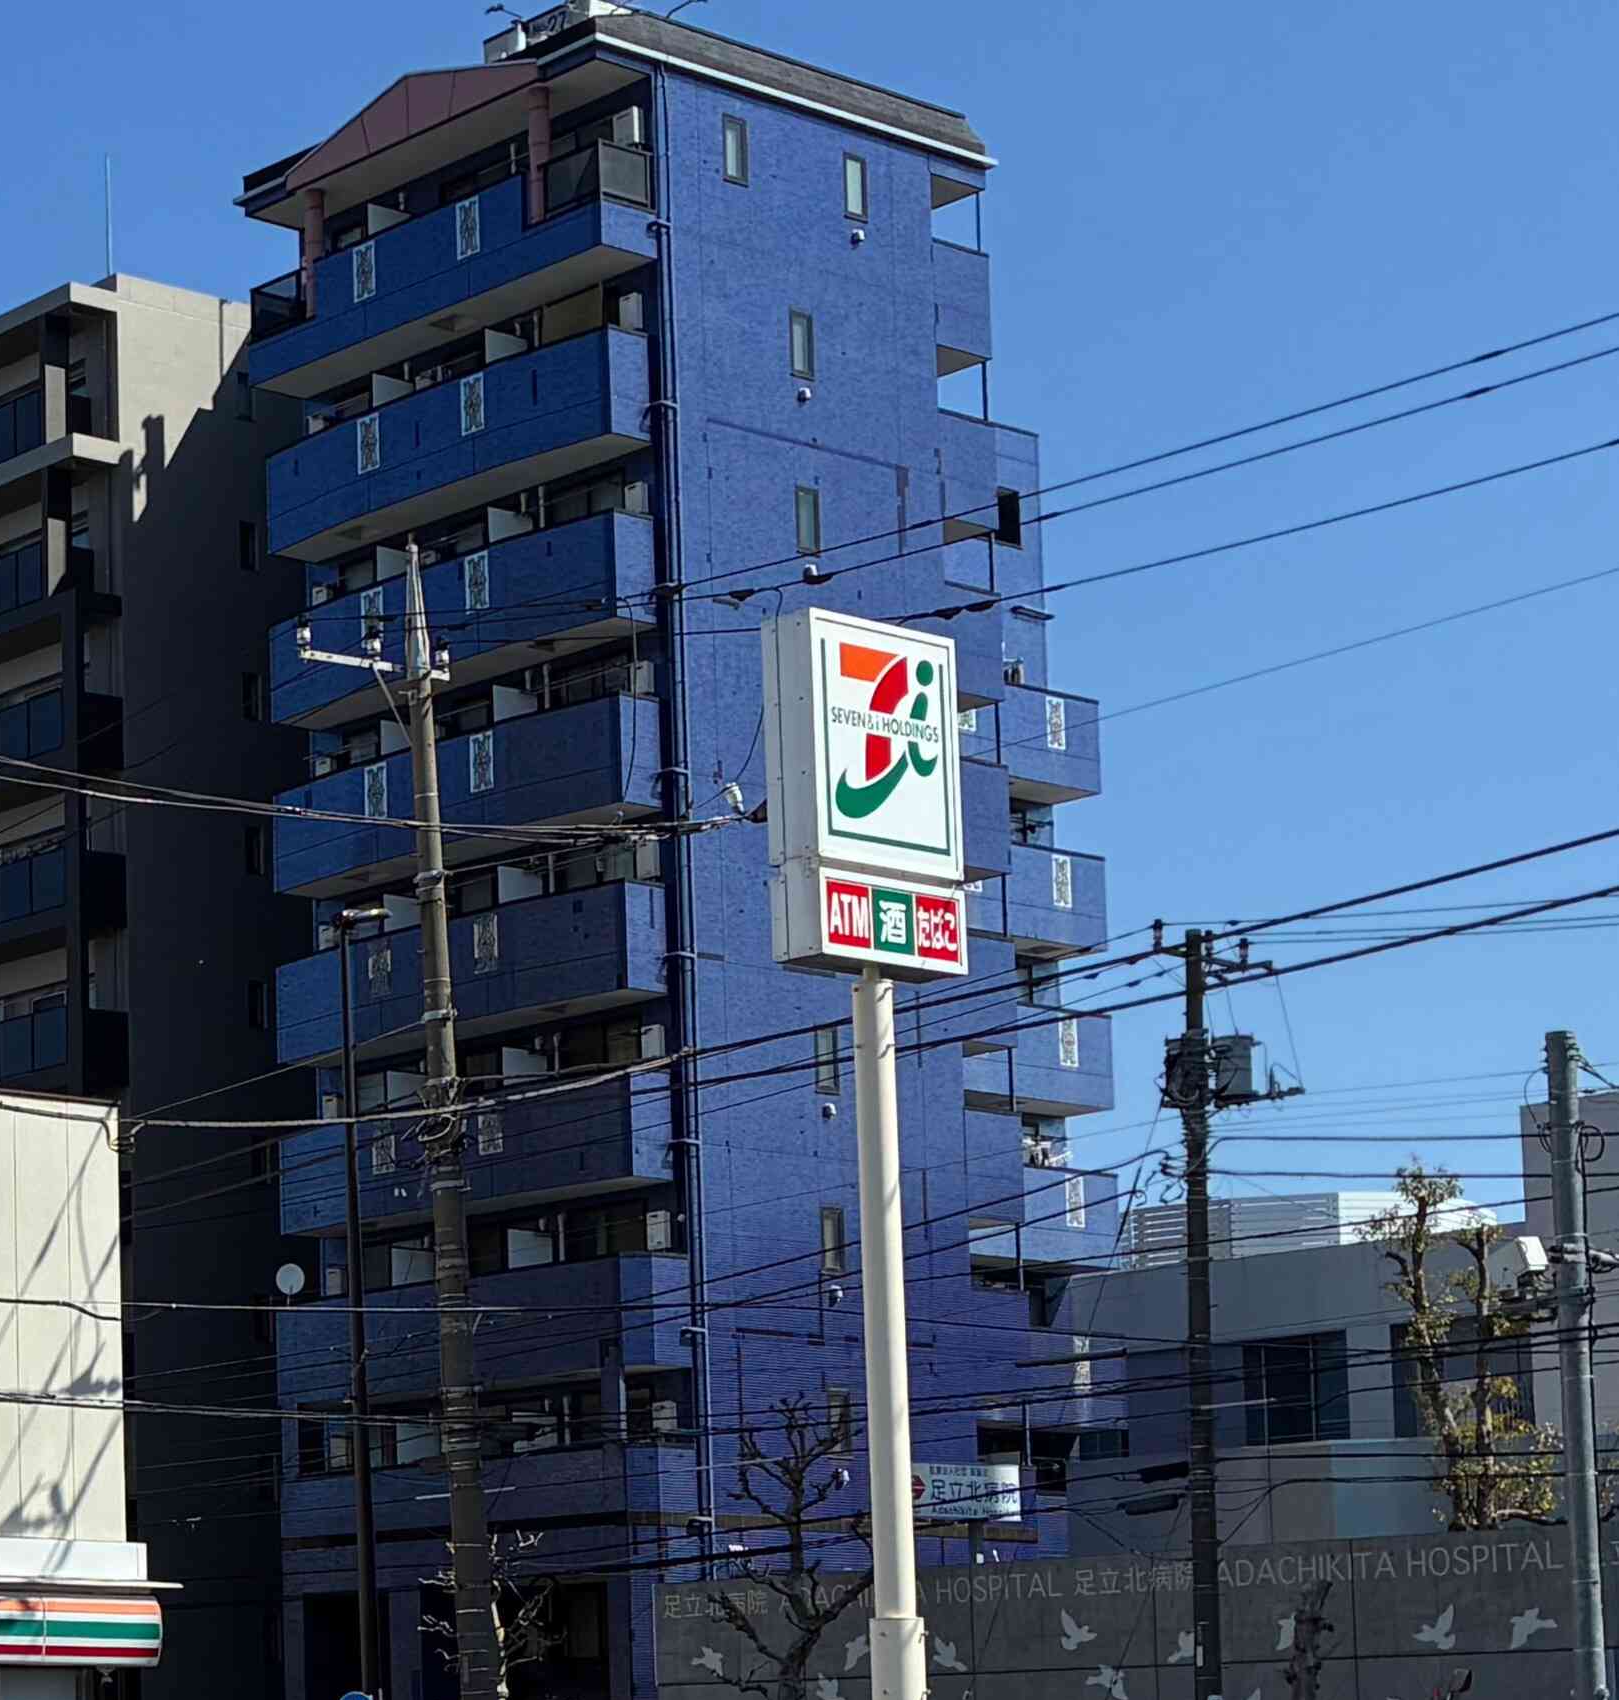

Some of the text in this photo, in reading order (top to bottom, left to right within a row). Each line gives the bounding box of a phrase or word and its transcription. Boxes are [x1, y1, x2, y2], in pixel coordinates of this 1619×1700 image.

[882, 717, 939, 743] HOLDINGS
[829, 891, 869, 939] ATM
[879, 900, 906, 944] 酒
[918, 906, 957, 951] たばこ
[930, 1479, 1018, 1503] 足立北病院
[1074, 1561, 1193, 1595] 足立北病院
[1217, 1551, 1397, 1588] ADACHIKITA
[1407, 1540, 1565, 1577] HOSPITAL
[936, 1568, 1064, 1604] HOSPITAL
